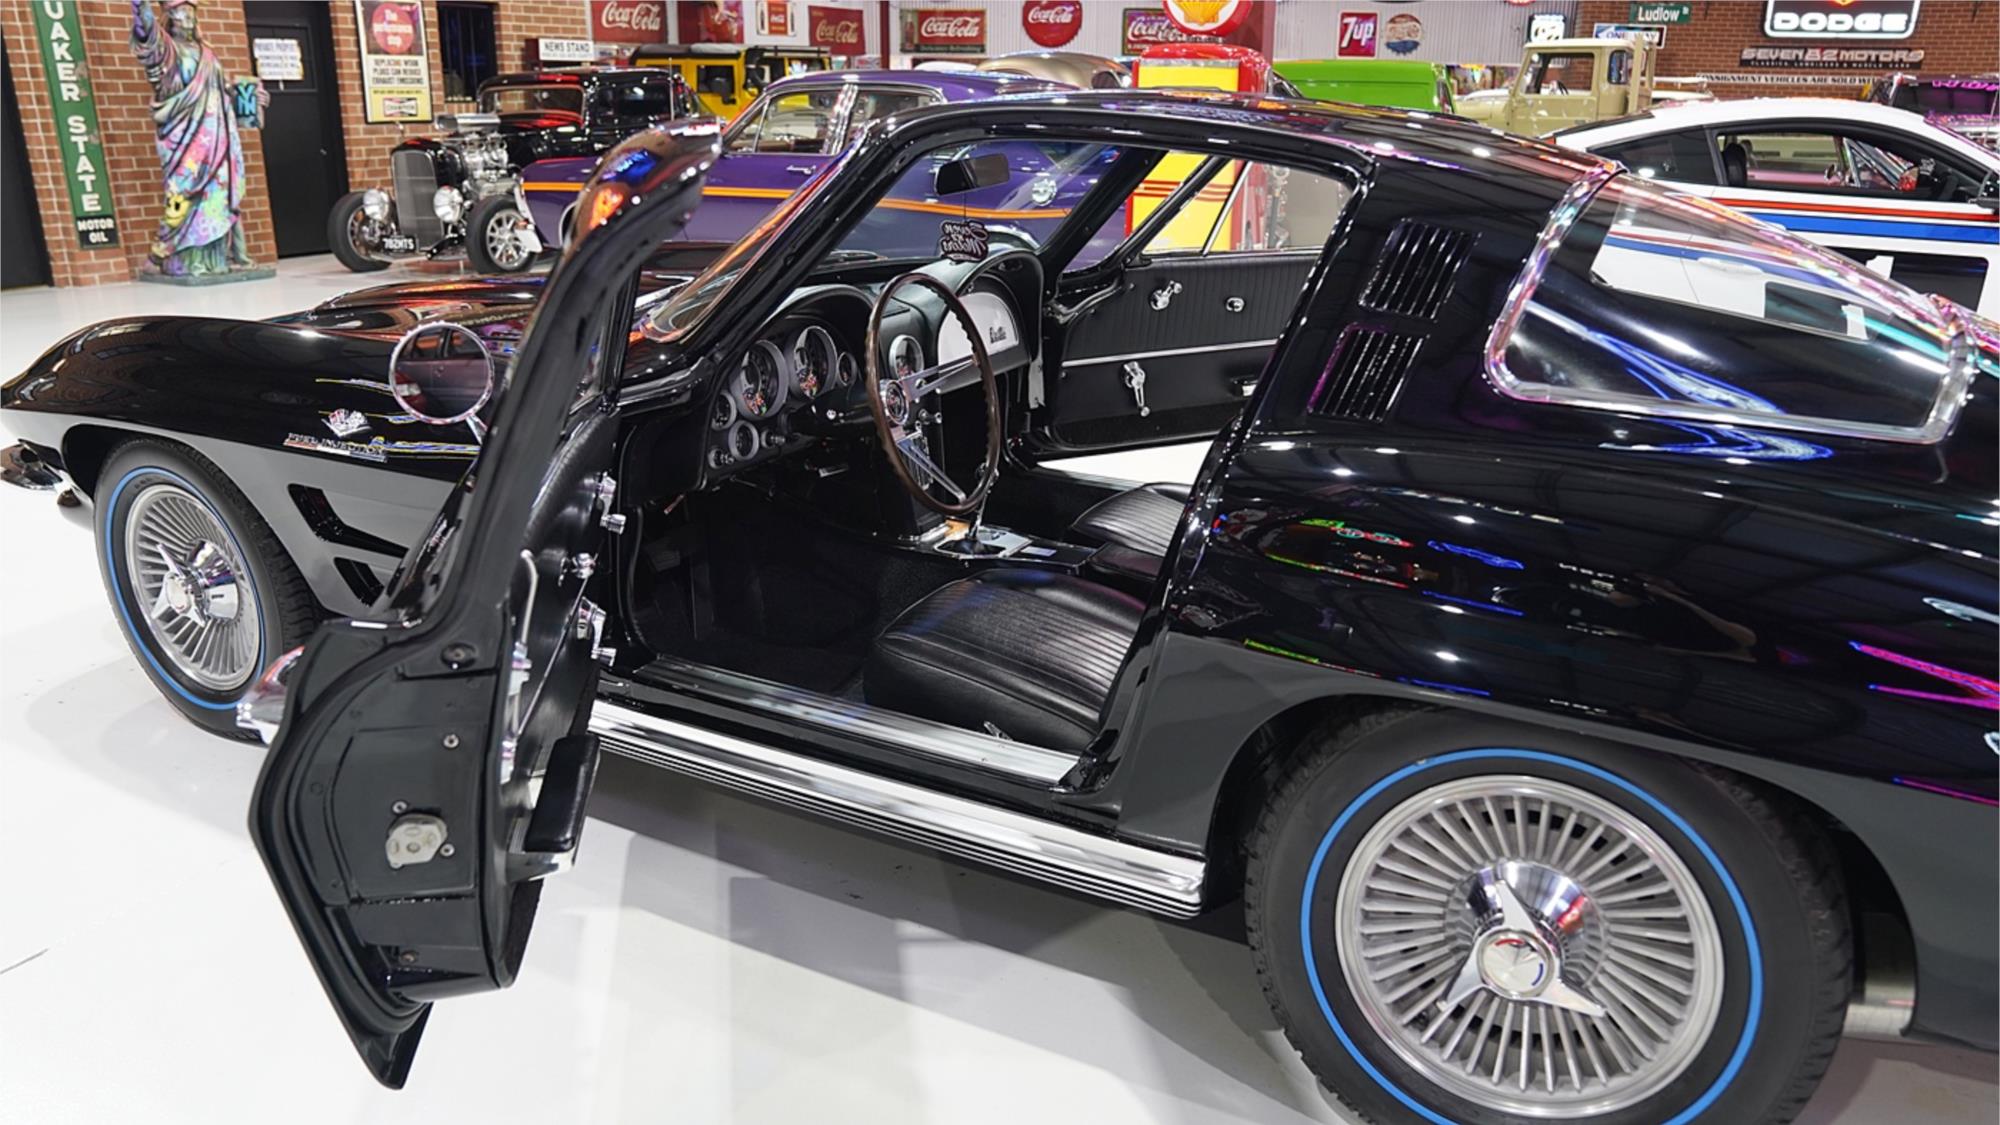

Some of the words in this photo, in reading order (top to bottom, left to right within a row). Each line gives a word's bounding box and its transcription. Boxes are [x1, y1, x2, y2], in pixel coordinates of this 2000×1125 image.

[601, 1, 660, 31] Coca-Cola
[1028, 6, 1074, 24] Coca-Cola
[1638, 6, 1680, 21] Ludlow
[1773, 12, 1908, 31] DODGE
[816, 18, 859, 44] Coca-Cola
[921, 16, 982, 38] Coca-Cola
[1340, 16, 1374, 48] 7up
[544, 42, 564, 52] NEWS
[567, 42, 589, 53] STAND
[1741, 48, 1804, 60] SEVEN
[1839, 49, 1924, 62] MOTORS
[1765, 75, 1809, 84] VEHICLES
[67, 115, 102, 212] STATE
[77, 217, 114, 231] MOTOR
[89, 231, 108, 243] OIL
